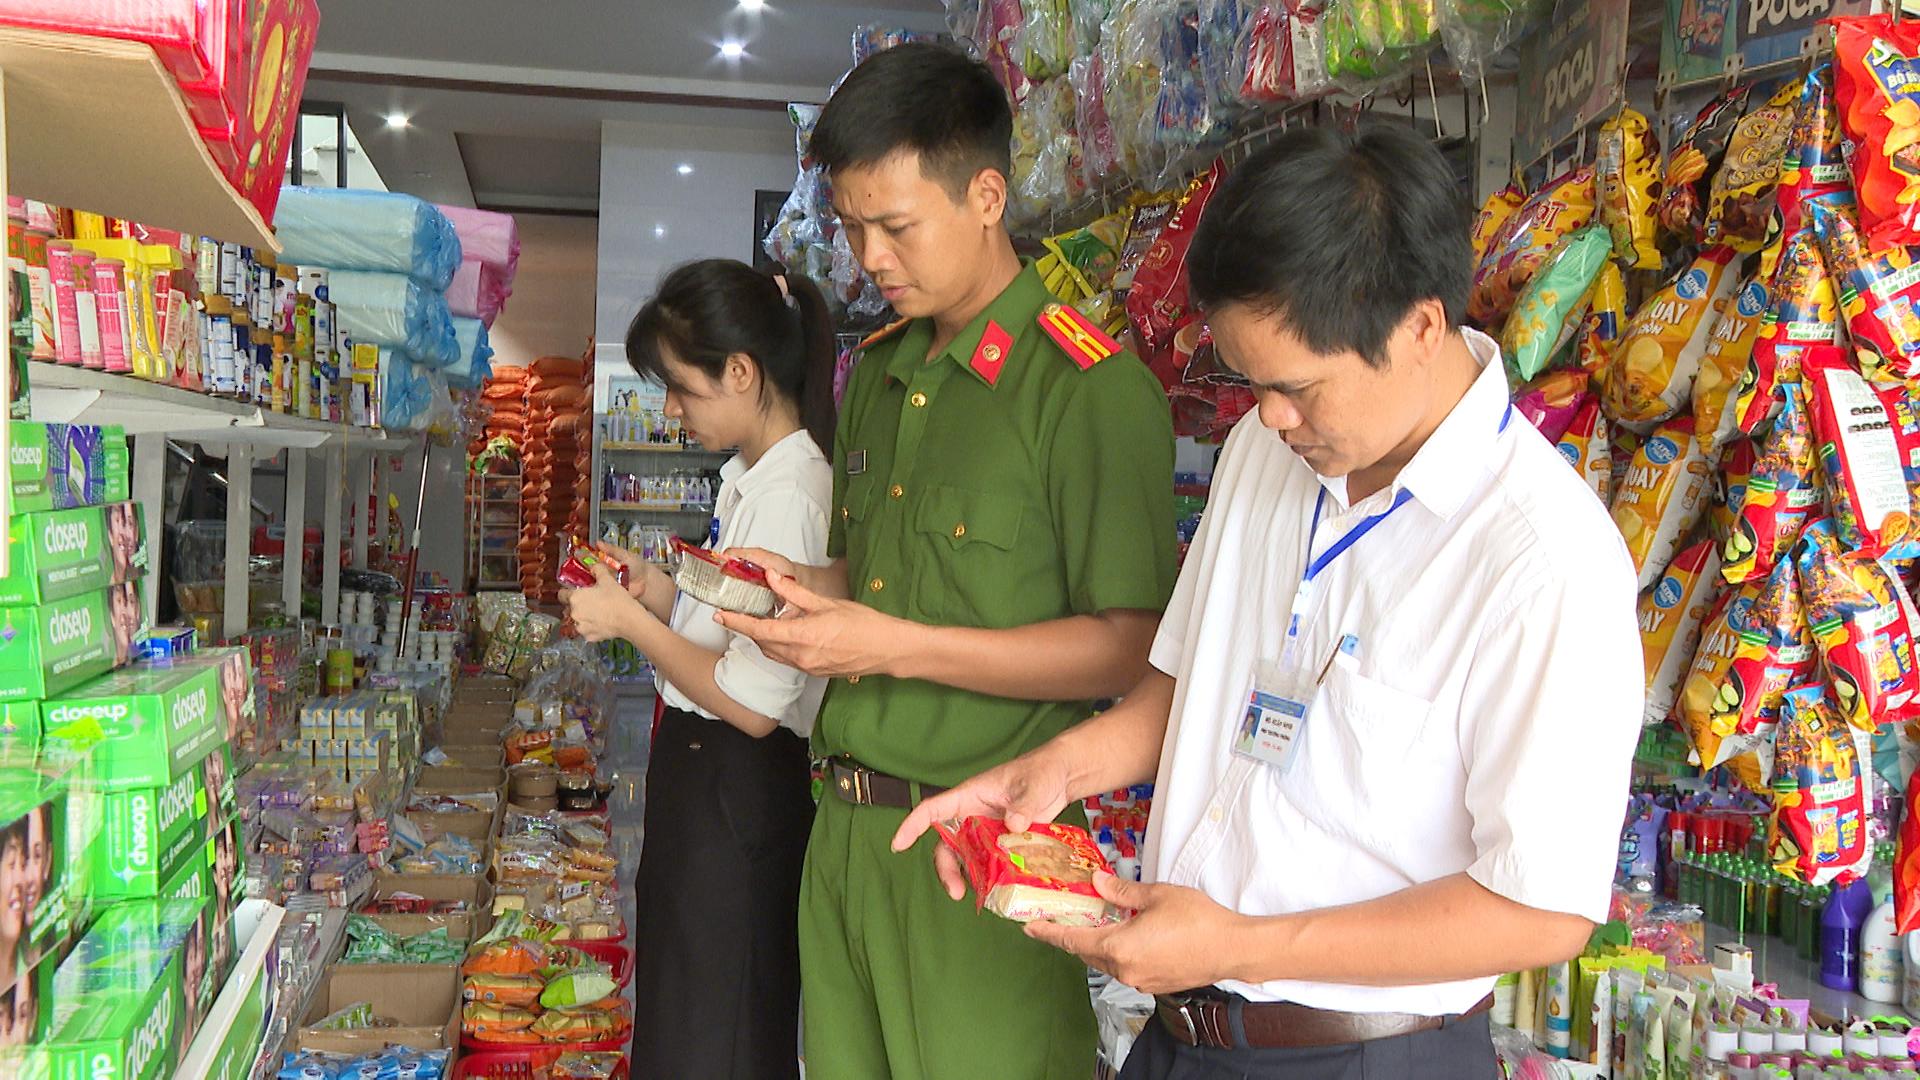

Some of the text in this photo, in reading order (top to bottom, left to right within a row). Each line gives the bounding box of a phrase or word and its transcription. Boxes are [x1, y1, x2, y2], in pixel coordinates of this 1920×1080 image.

[1544, 40, 1594, 123] POCA
[44, 517, 88, 560] closeup
[49, 606, 91, 646] closeup
[50, 703, 127, 722] closeup
[172, 687, 207, 731] closeup
[158, 771, 195, 832] closeup
[130, 795, 150, 867] closeup
